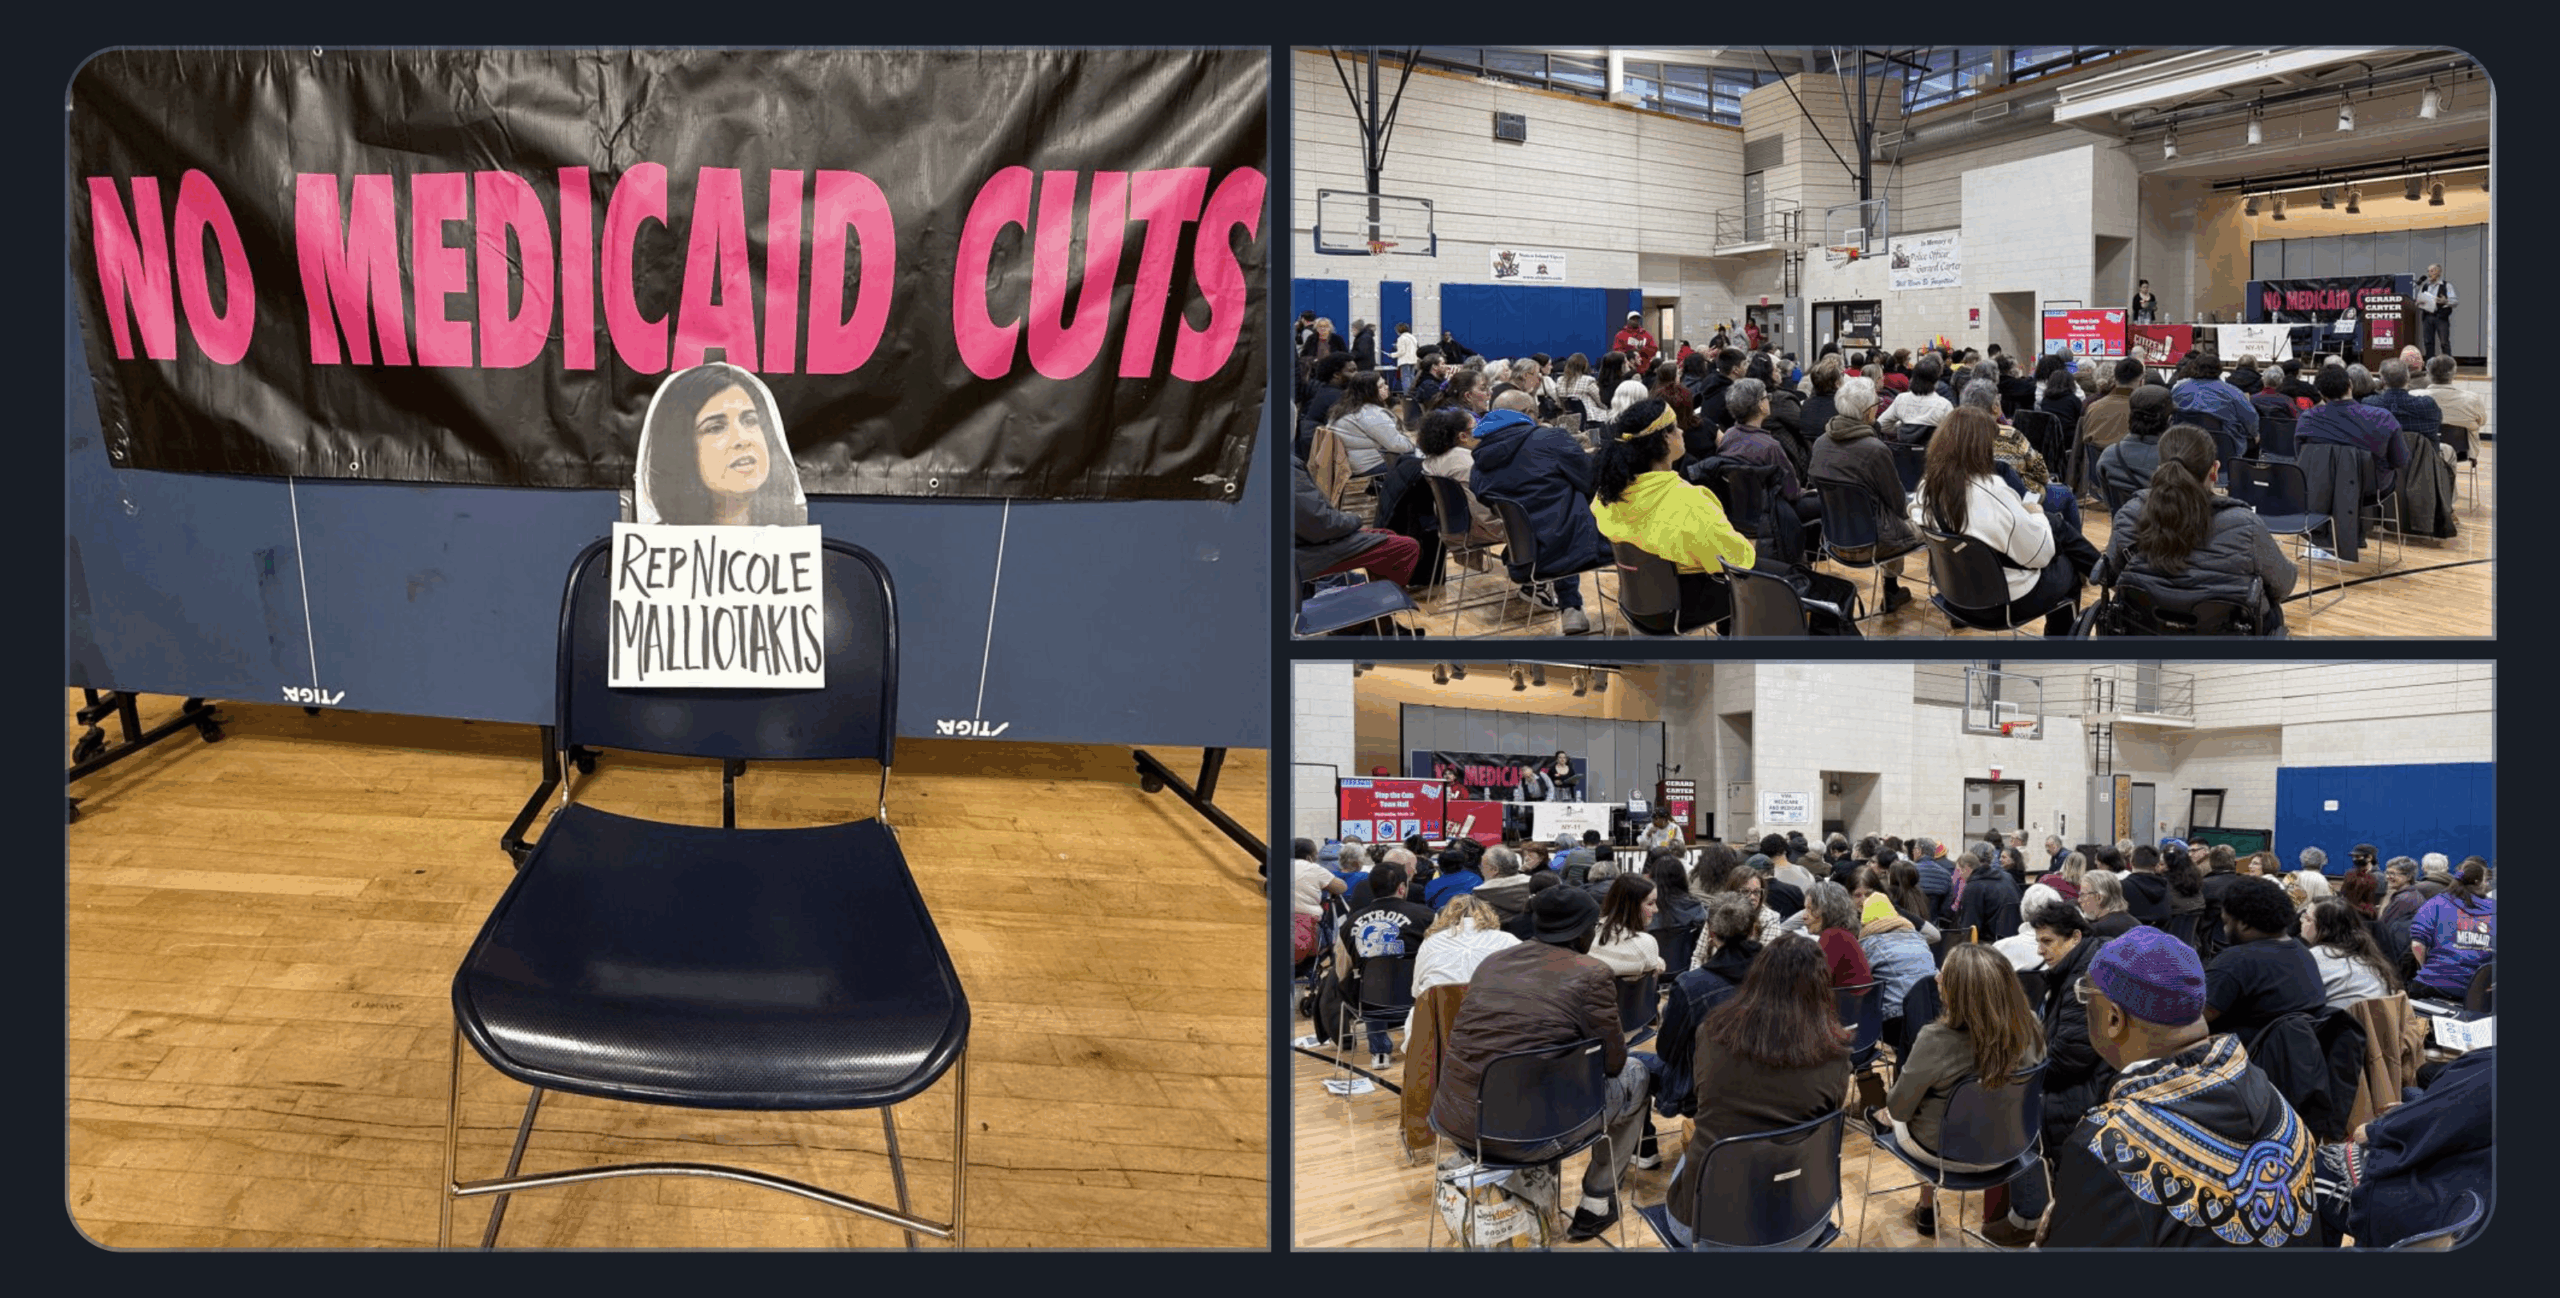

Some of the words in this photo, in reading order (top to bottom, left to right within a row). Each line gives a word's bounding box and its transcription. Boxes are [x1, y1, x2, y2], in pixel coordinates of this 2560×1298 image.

[87, 168, 255, 365] NO
[295, 162, 896, 375] MEDICAID
[953, 166, 1267, 382] CUTS
[2264, 291, 2282, 310] NO
[2286, 289, 2350, 310] MEDICAID
[612, 600, 822, 681] MALLIOTAKIS
[1561, 823, 1581, 831] NY-11
[1350, 909, 1413, 937] DETROIT
[2456, 930, 2491, 947] MEDICAID
